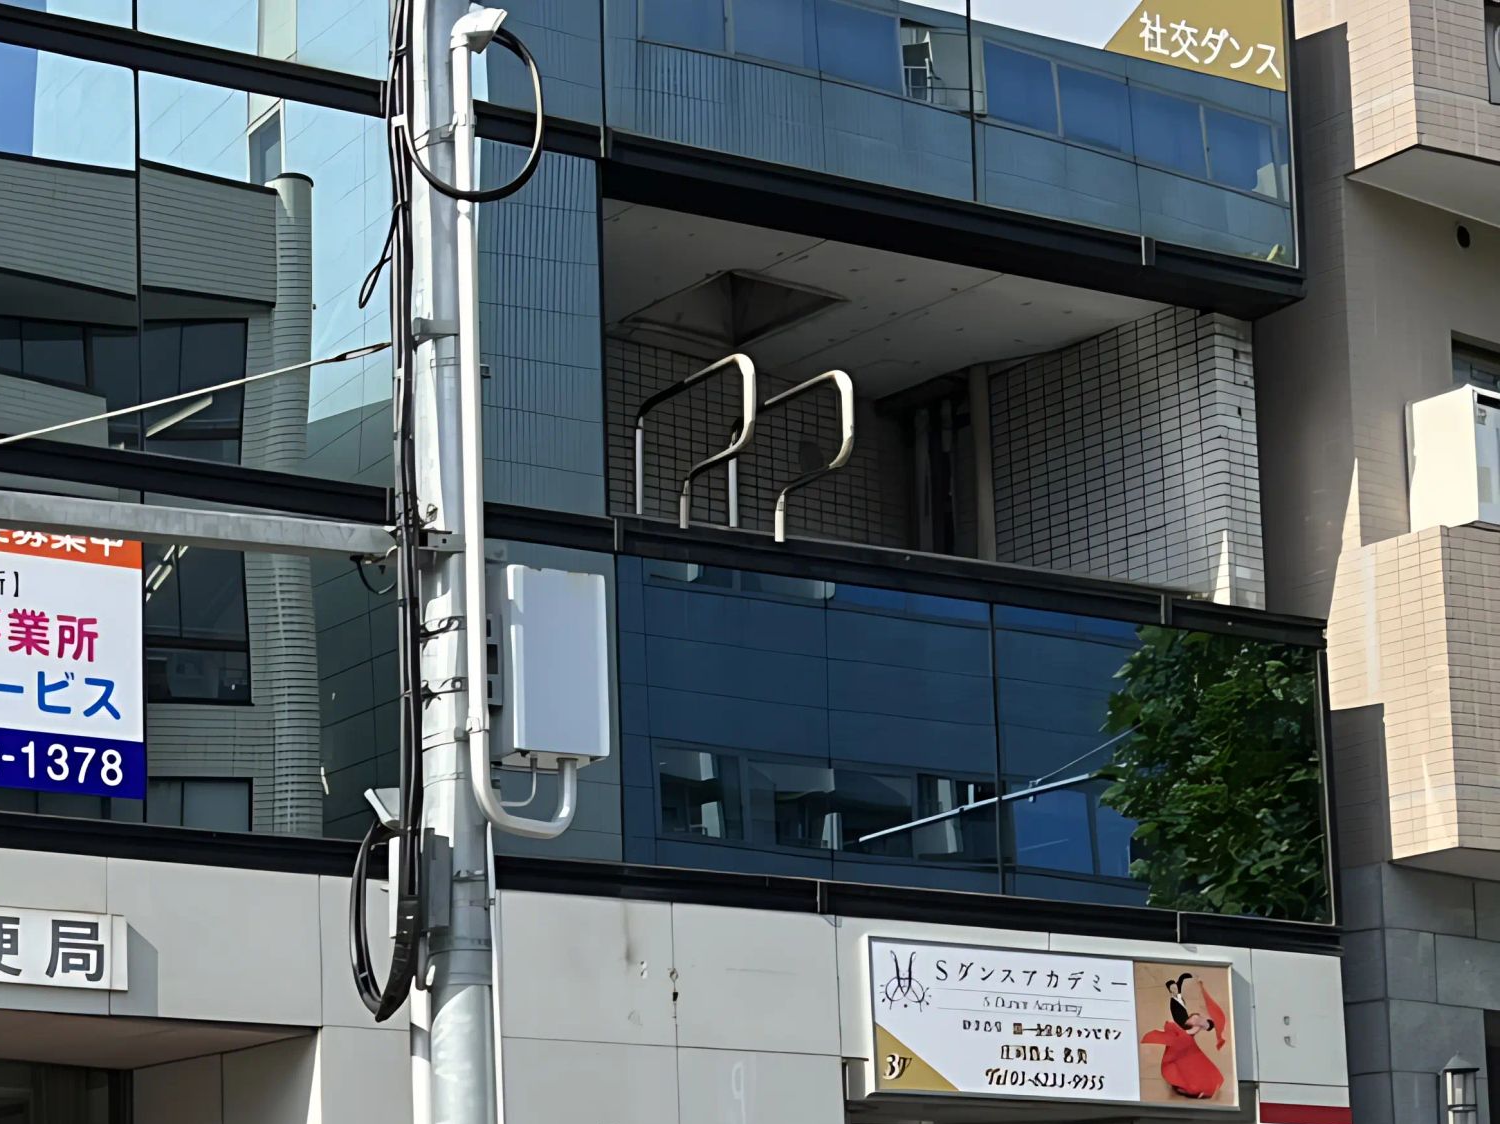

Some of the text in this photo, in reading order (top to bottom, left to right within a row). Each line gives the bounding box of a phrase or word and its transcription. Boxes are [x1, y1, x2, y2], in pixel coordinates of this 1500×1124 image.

[1139, 11, 1282, 78] 社交ダンス
